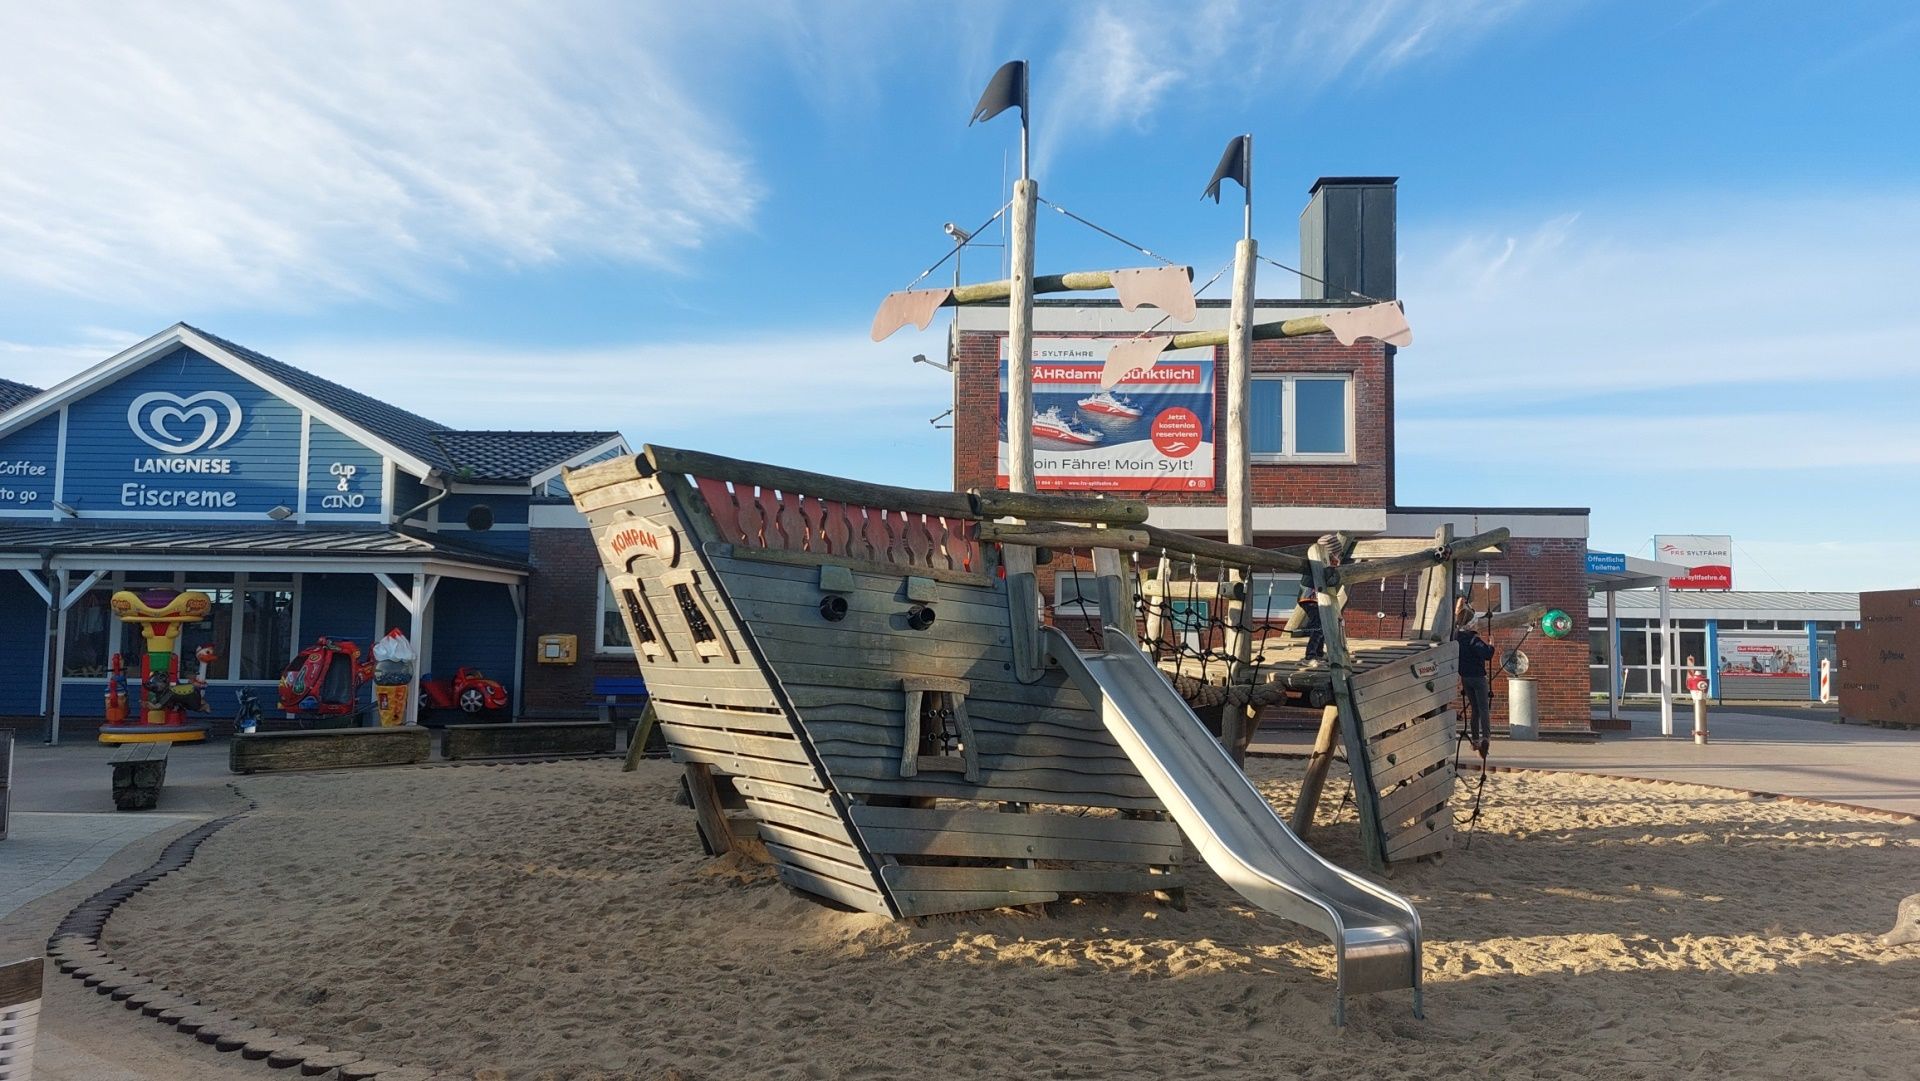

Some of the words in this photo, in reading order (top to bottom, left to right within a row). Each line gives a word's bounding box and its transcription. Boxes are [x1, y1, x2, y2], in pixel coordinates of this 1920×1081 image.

[1121, 367, 1195, 382] pünktlich!
[0, 461, 46, 476] Coffee
[133, 458, 231, 474] LANGNESE
[329, 462, 356, 479] Cup
[1034, 458, 1057, 470] oin
[1062, 458, 1110, 470] Fähre!
[1115, 459, 1154, 470] Moin
[1158, 459, 1193, 473] Sylt!
[336, 477, 350, 492] &
[0, 487, 15, 500] to
[19, 490, 38, 504] go
[121, 482, 237, 508] Eiscreme
[321, 494, 365, 509] CINO
[610, 528, 660, 557] KOMPAN
[1587, 553, 1624, 562] Öffentliche
